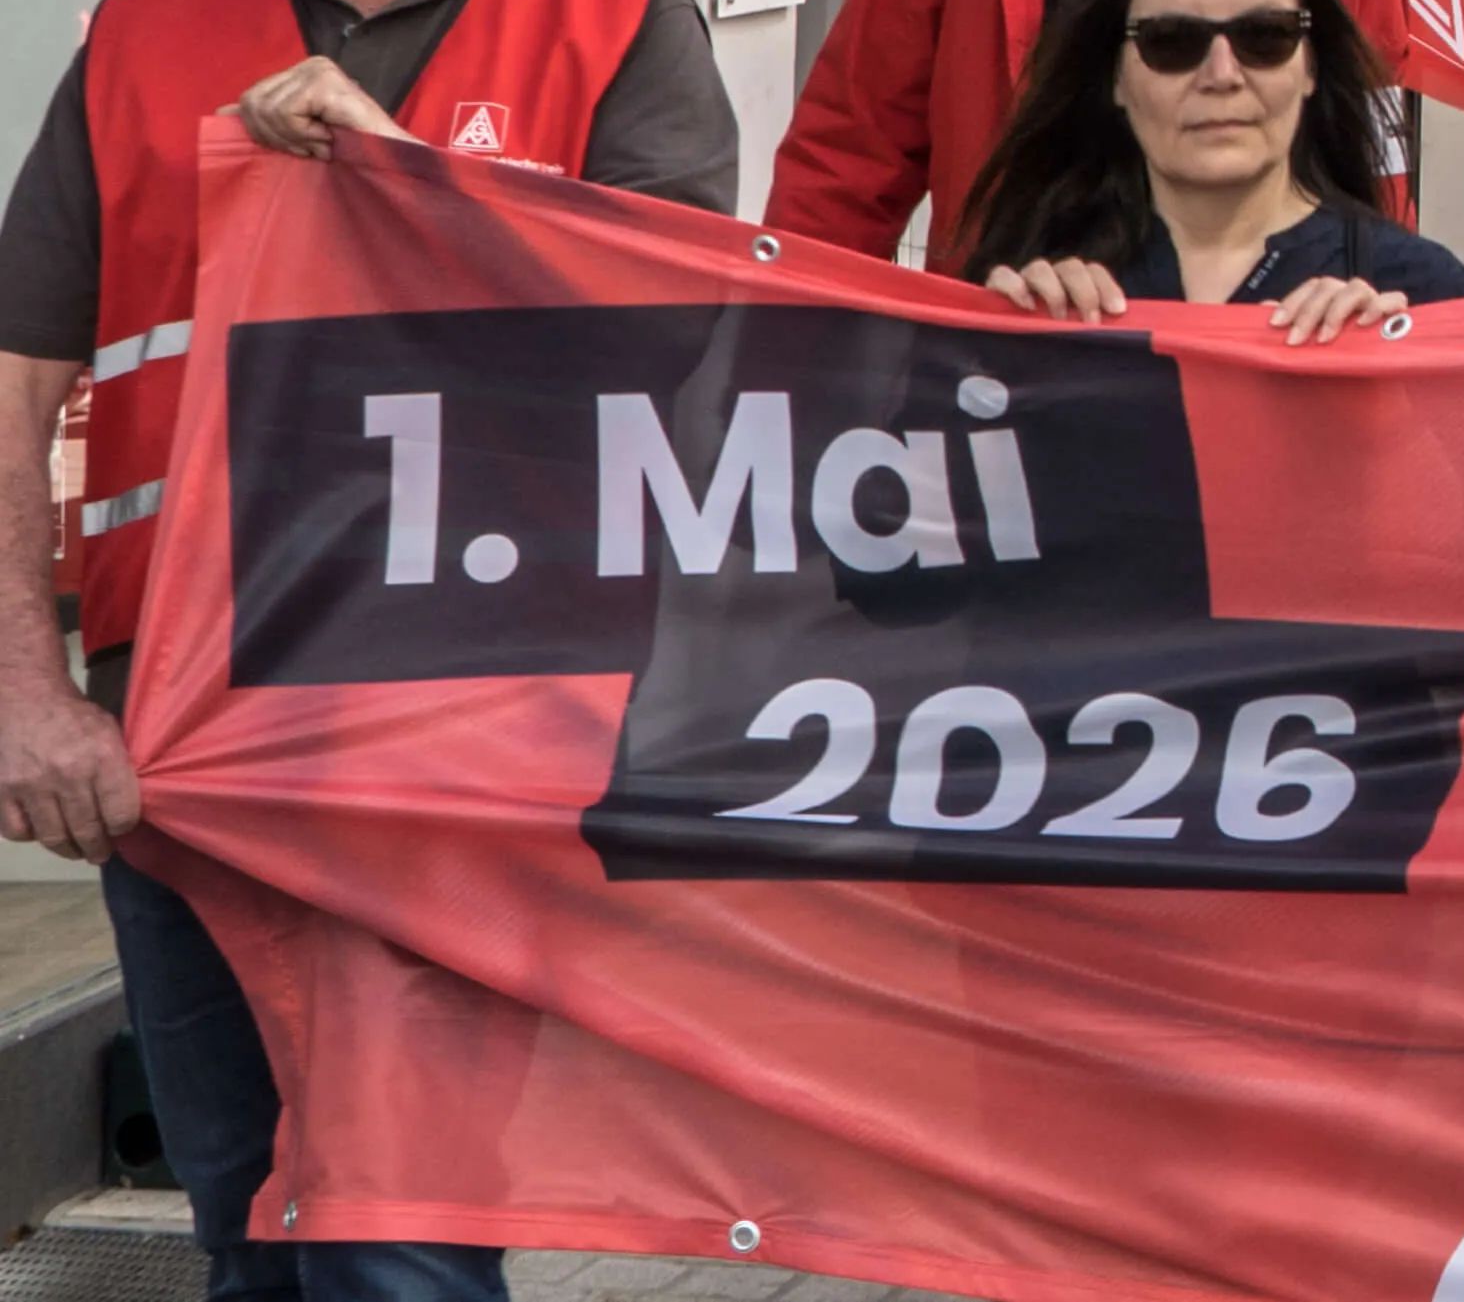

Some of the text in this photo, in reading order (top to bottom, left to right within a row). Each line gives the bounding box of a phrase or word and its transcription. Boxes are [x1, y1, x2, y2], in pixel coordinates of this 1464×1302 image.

[363, 375, 1041, 585] 1. Mai
[714, 679, 1359, 842] 2026
